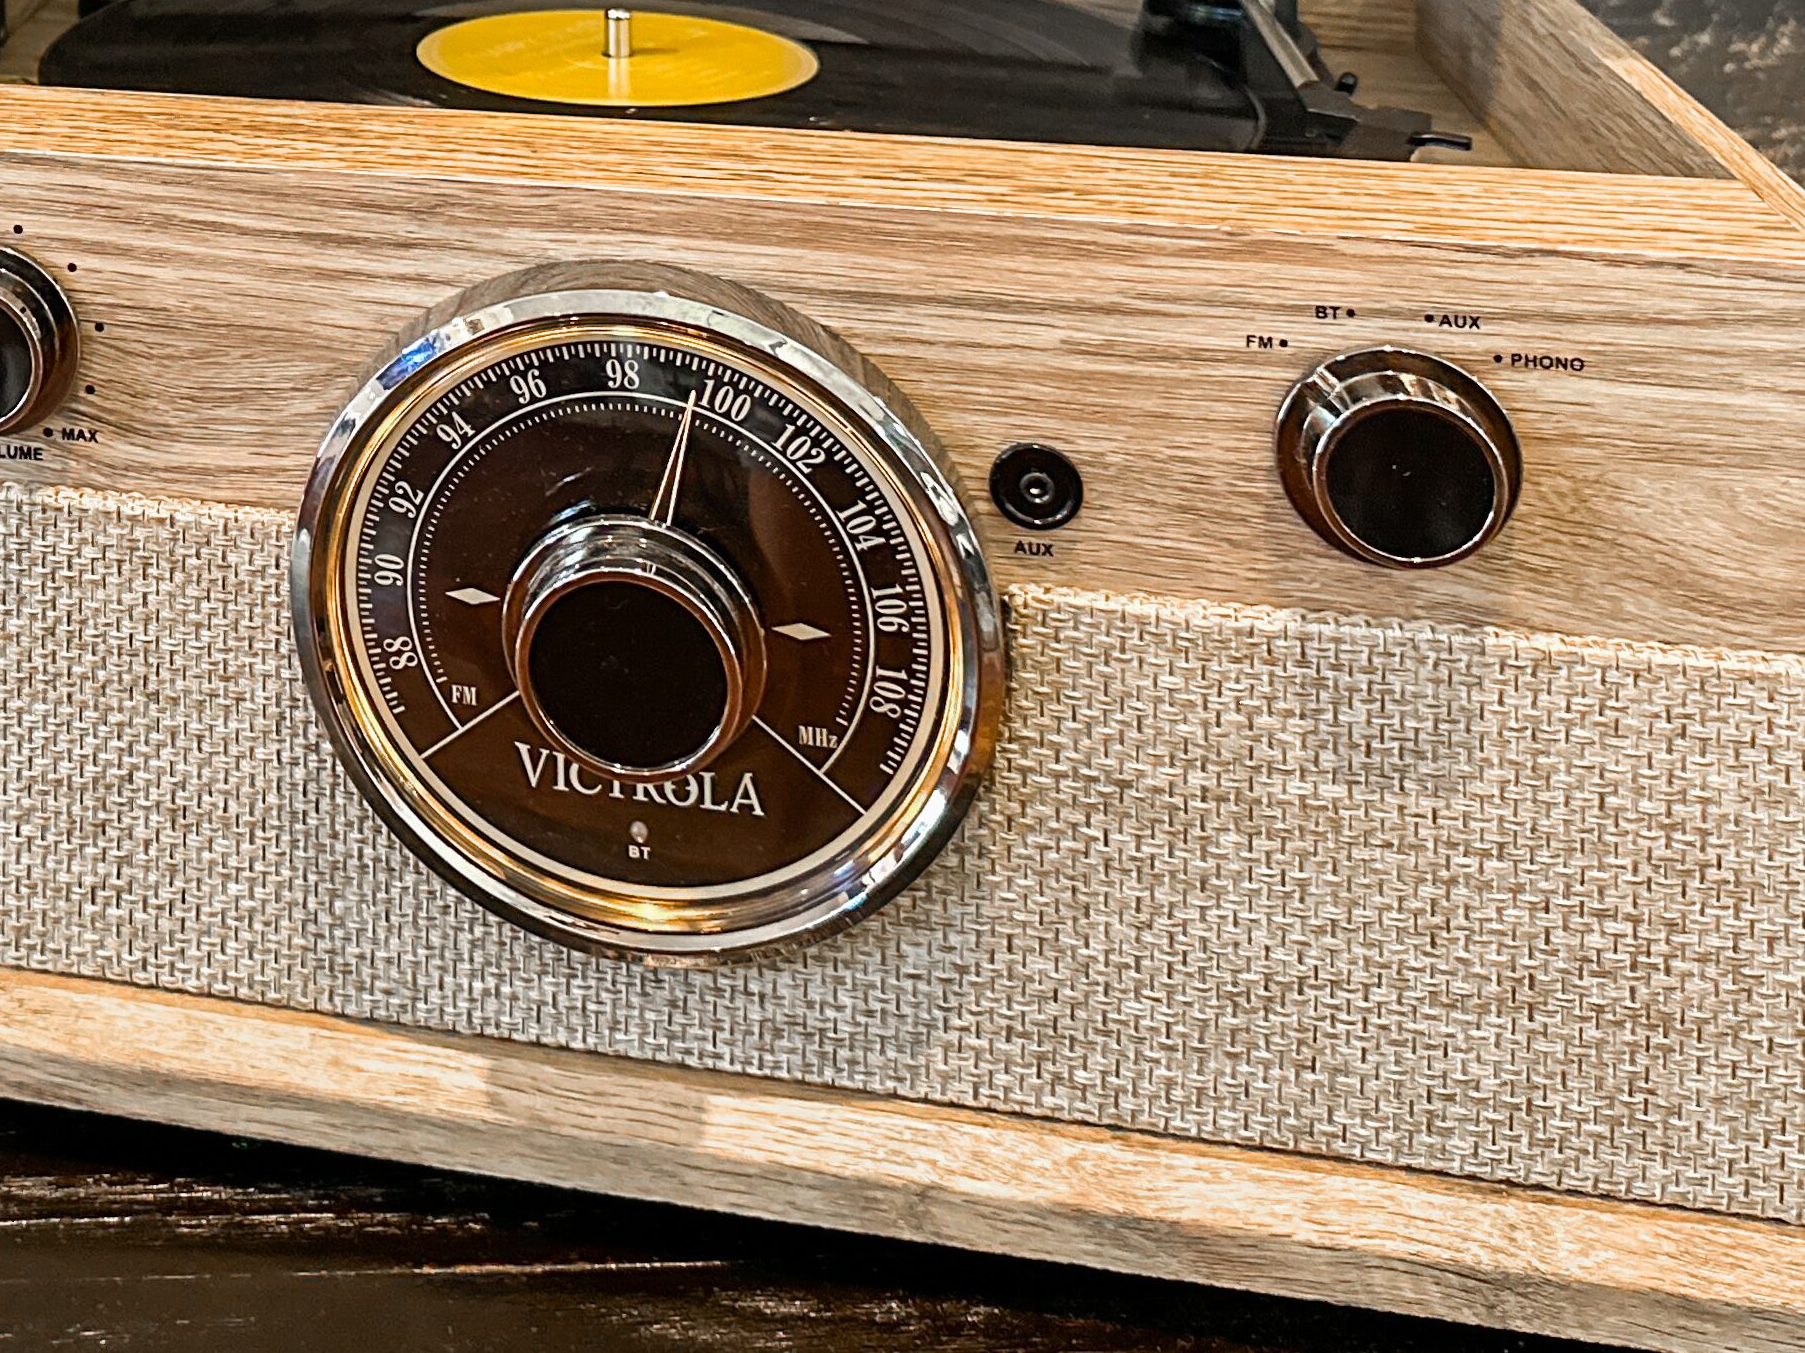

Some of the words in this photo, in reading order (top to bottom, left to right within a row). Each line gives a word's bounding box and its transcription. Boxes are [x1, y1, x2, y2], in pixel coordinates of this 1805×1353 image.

[1315, 305, 1341, 320] BT
[1439, 314, 1481, 330] AUX
[1246, 334, 1273, 349] FM
[605, 358, 640, 390] 98
[1511, 353, 1586, 372] PHONO
[509, 368, 547, 404] 96
[697, 379, 752, 422] 100
[61, 427, 99, 444] MAX
[437, 411, 477, 450] 94
[771, 423, 828, 475] 102
[388, 480, 425, 519] 92
[836, 499, 886, 552] 104
[1014, 540, 1054, 557] AUX
[374, 553, 406, 587] 90
[870, 583, 910, 634] 106
[383, 636, 419, 671] 88
[451, 684, 478, 707] FM
[869, 665, 909, 719] 108
[798, 724, 839, 749] MHz
[628, 844, 652, 860] BT
